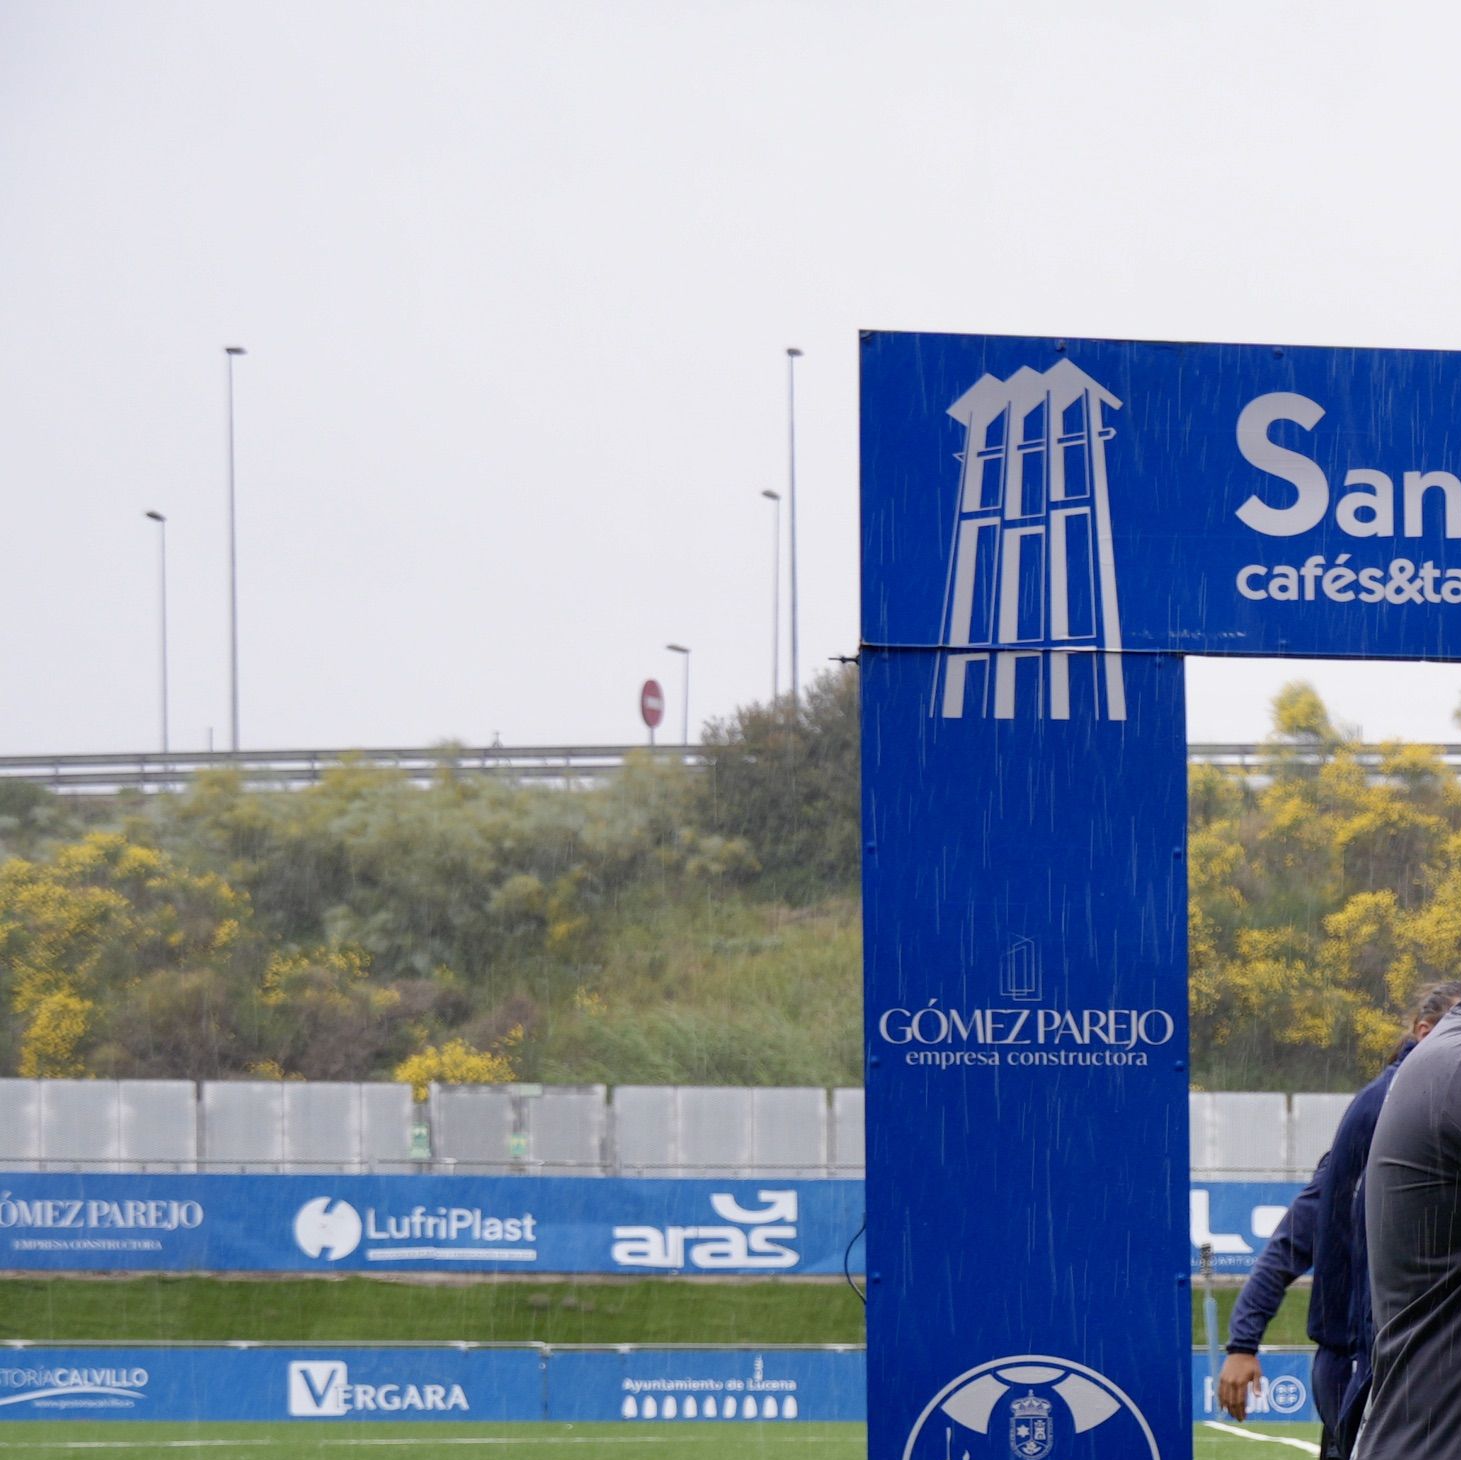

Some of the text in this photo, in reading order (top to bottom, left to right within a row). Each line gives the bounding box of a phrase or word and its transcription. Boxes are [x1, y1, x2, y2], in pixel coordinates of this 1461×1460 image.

[879, 998, 1175, 1051] GÓMEZ PAREJO
[905, 1050, 1148, 1070] empresa constructora
[88, 1199, 204, 1231] PAREJO
[366, 1205, 537, 1242] LufriPlast
[622, 1378, 797, 1394] Ayuntamiento de Lucena
